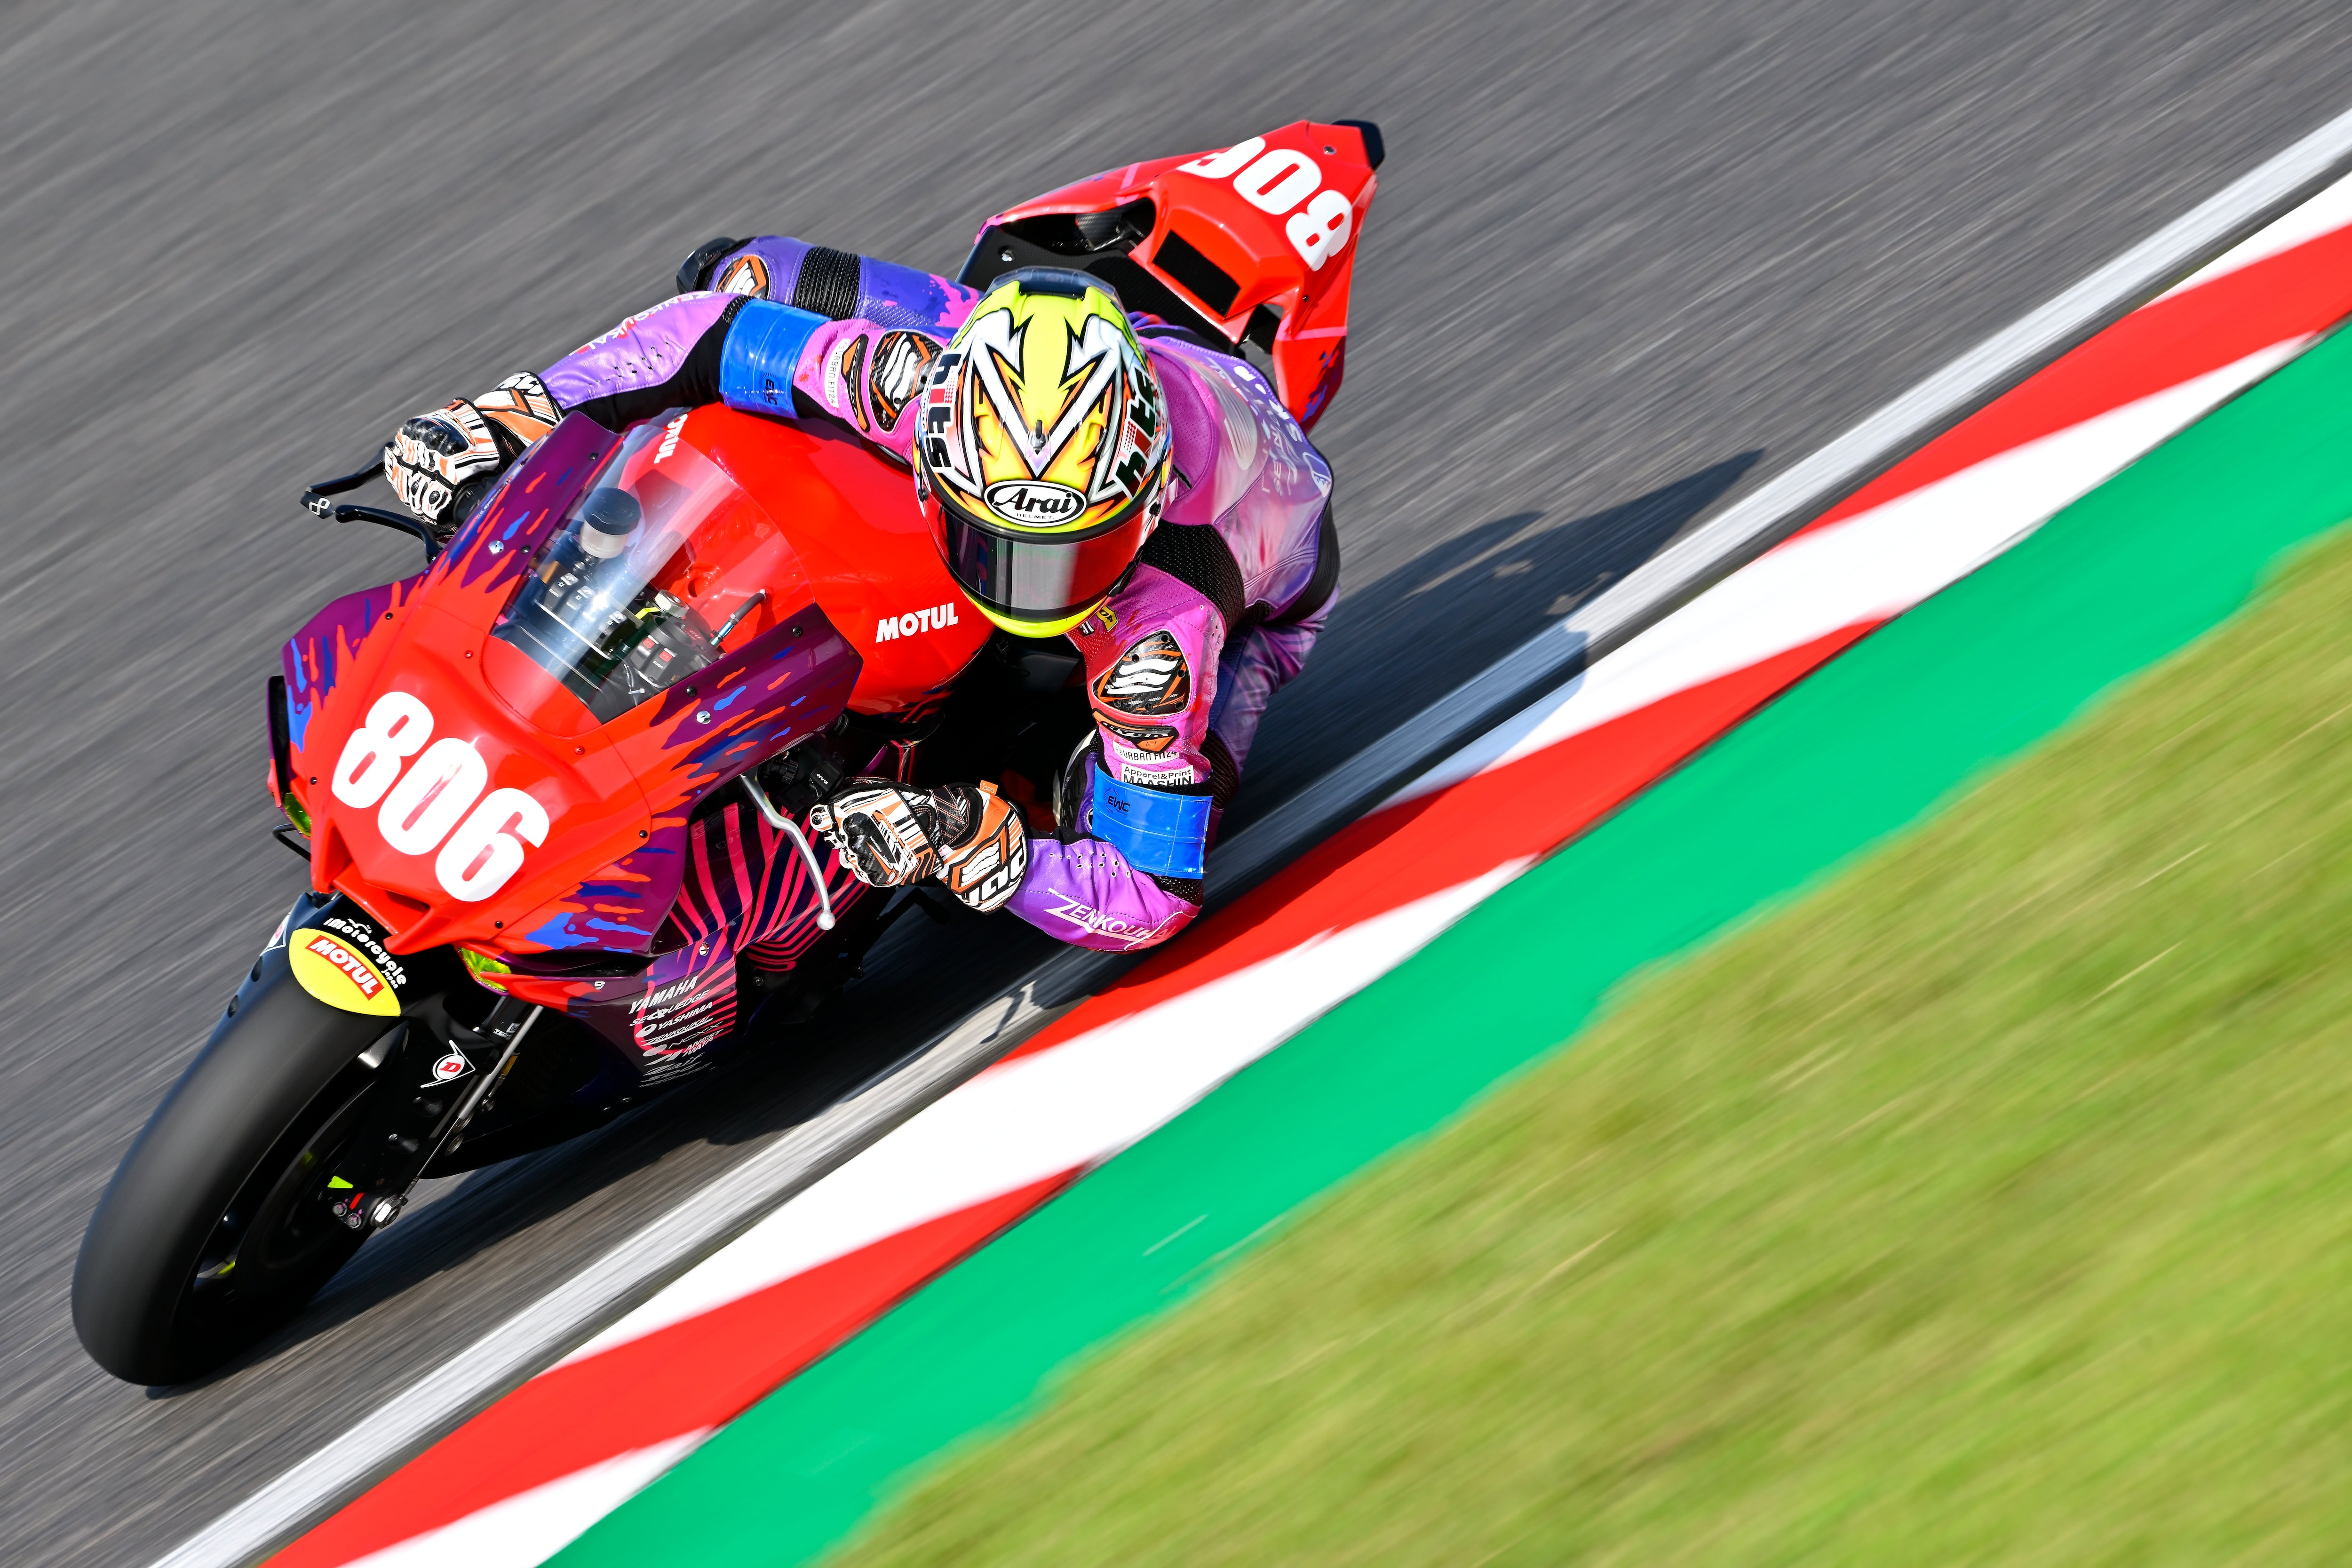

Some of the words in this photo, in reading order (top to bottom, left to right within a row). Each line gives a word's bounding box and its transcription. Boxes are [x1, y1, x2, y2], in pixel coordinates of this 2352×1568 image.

[653, 414, 688, 464] OTUL
[993, 488, 1073, 513] Arai
[875, 603, 959, 642] MOTUL
[1122, 751, 1152, 761] URBAN
[1124, 766, 1192, 780] Apparel&Print
[332, 691, 550, 902] 806
[1108, 795, 1131, 812] EWC
[310, 939, 378, 995] MOTUL
[628, 975, 698, 1014] YAMAHA
[629, 989, 710, 1027] SEQUEDGE
[658, 1002, 713, 1030] YASHIMA
